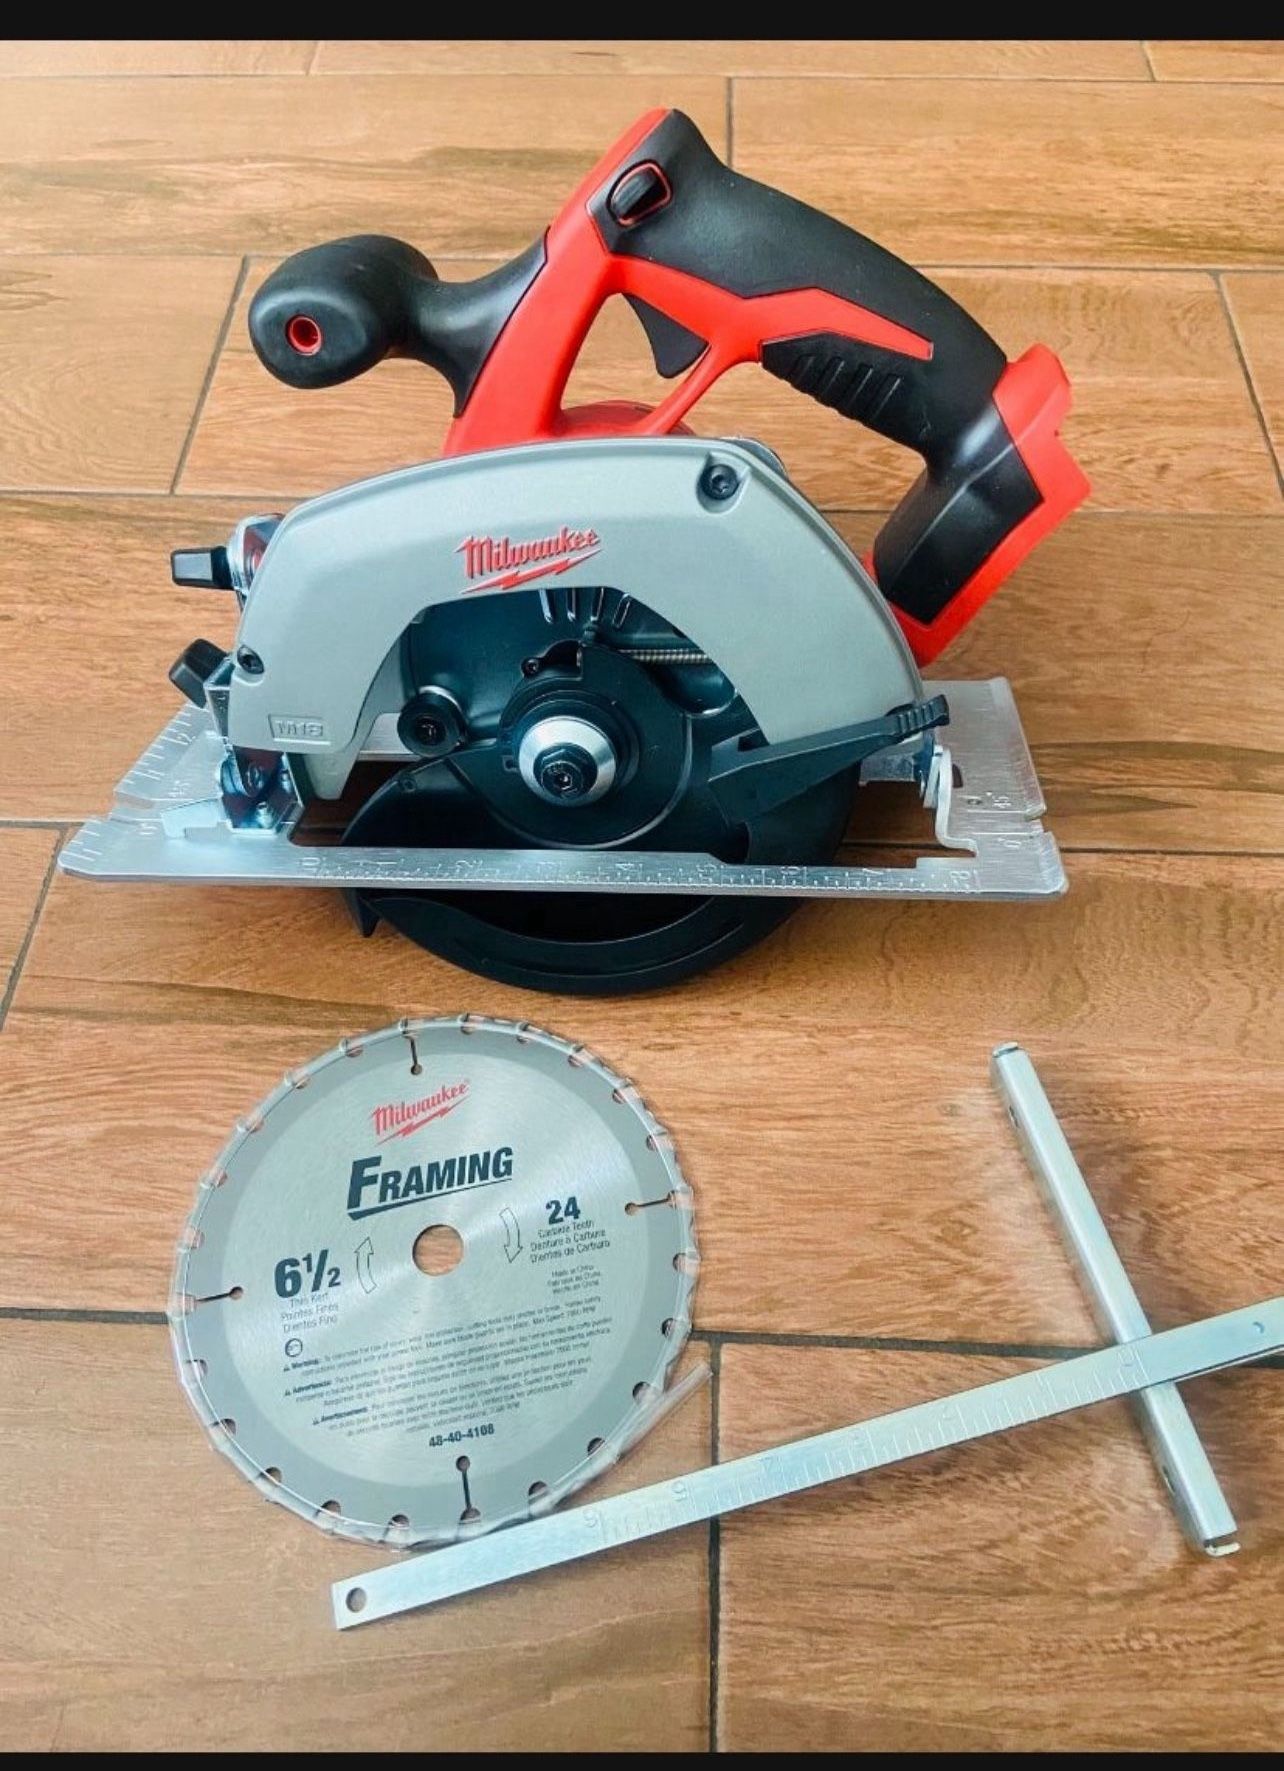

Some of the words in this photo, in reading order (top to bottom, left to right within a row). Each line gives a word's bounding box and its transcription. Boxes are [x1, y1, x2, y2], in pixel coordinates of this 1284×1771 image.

[454, 525, 601, 580] Milwaukee
[367, 1082, 470, 1135] Milwaukee
[348, 1147, 514, 1210] FRAMING
[545, 1196, 581, 1225] 24
[429, 1423, 495, 1447] 48-40-4108
